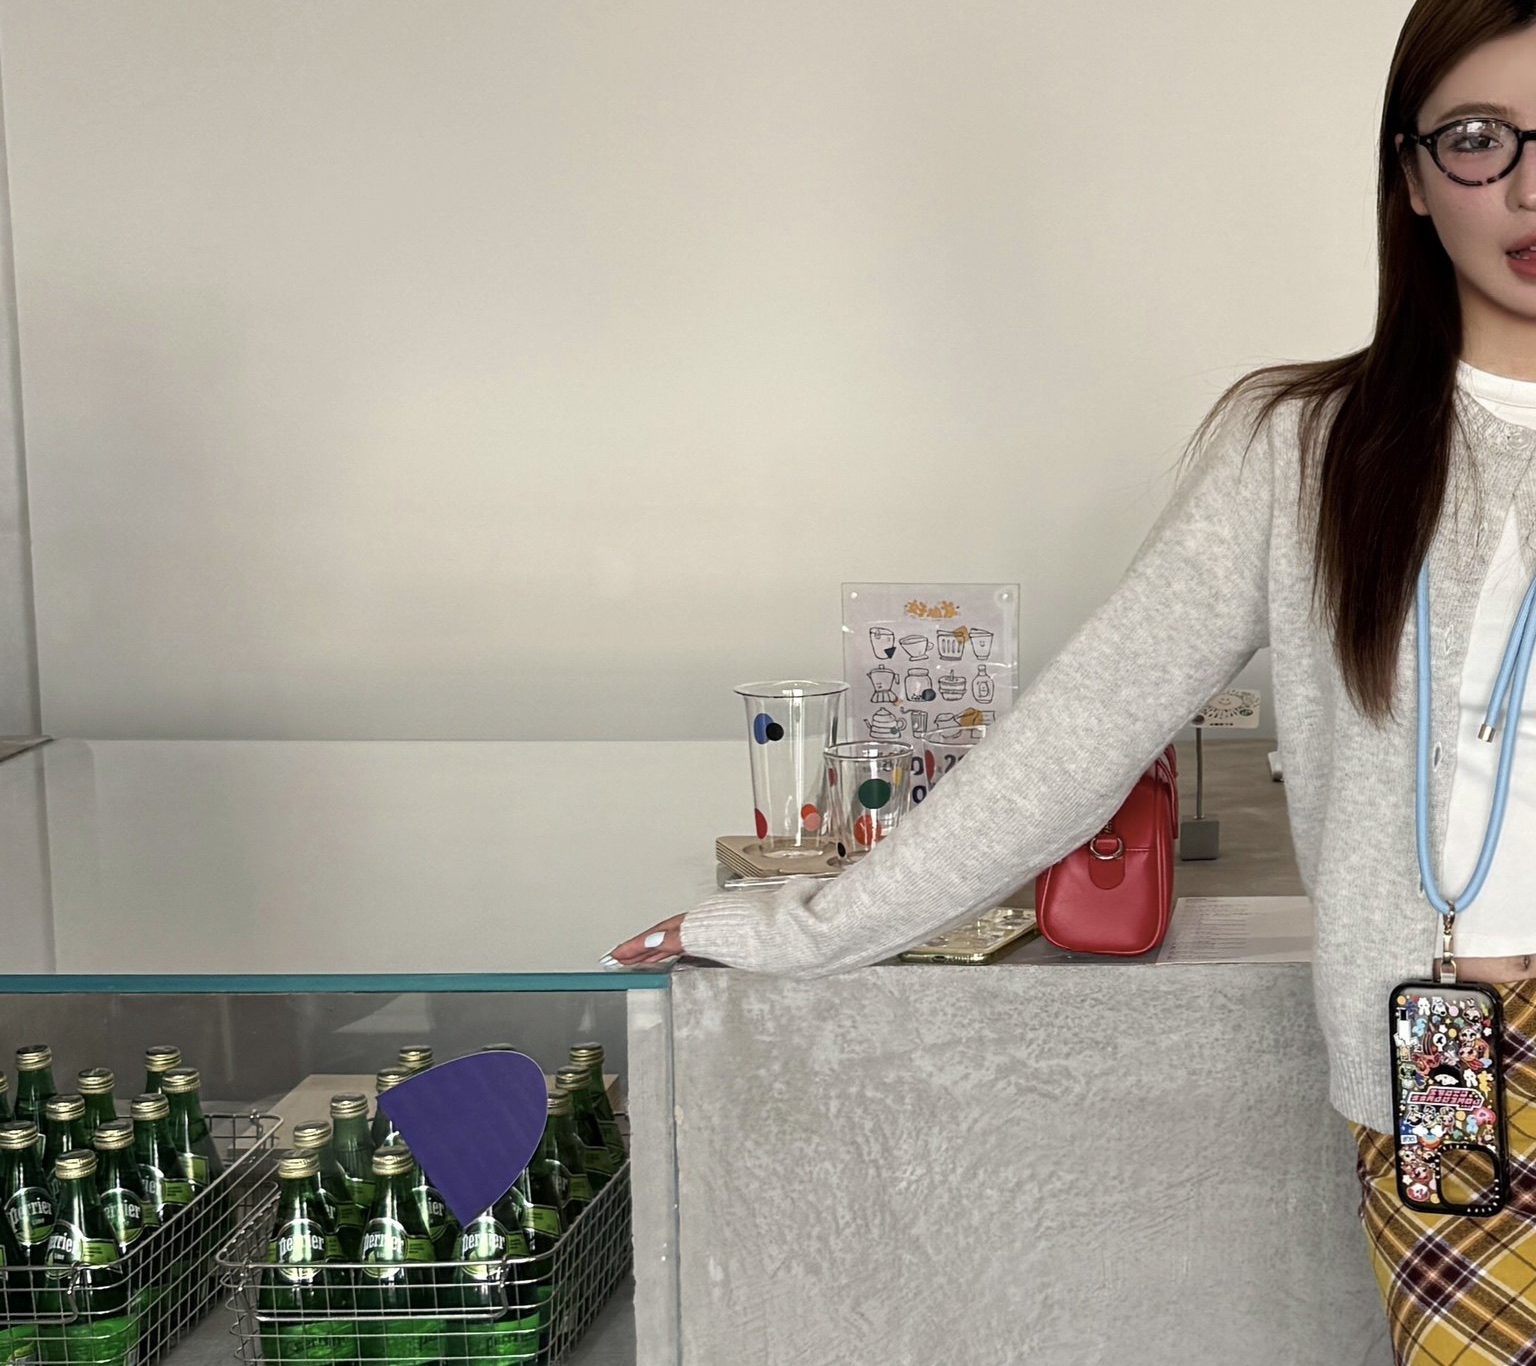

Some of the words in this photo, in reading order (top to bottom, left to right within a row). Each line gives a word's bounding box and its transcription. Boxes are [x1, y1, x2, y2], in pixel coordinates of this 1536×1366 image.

[279, 1229, 325, 1264] peer
[361, 1232, 405, 1261] perrer
[460, 1228, 506, 1260] perer
